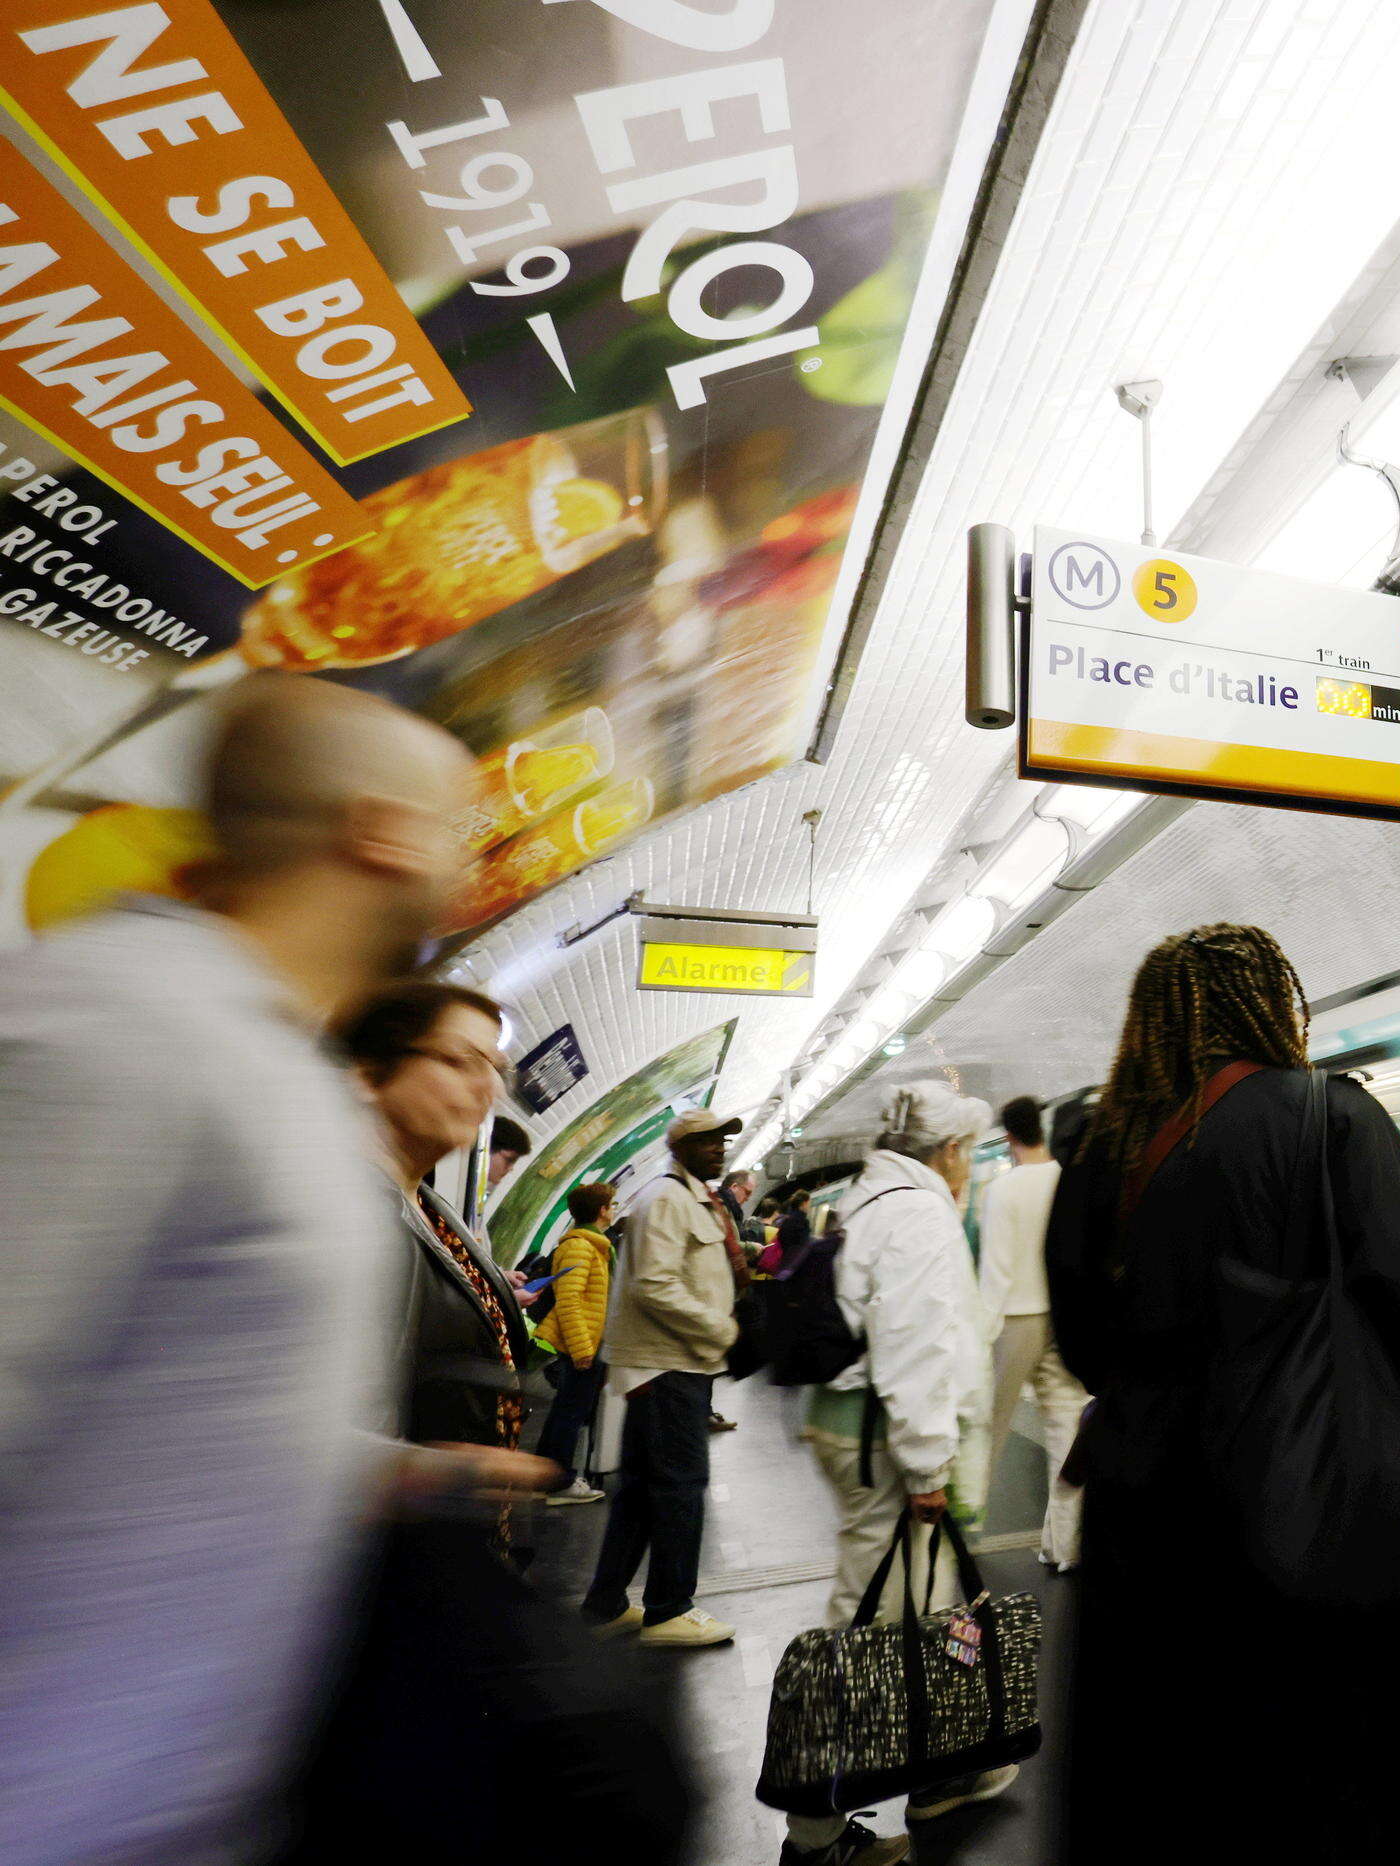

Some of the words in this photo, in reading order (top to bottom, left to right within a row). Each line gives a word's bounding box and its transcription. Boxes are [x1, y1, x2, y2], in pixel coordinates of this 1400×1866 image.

[17, 2, 245, 160] NE
[168, 176, 327, 278] SE
[254, 278, 434, 423] BOIT
[386, 96, 571, 297] 1919
[0, 203, 224, 452] AMAIS
[156, 437, 322, 550] SEUL
[0, 441, 118, 545] PEROL
[0, 525, 209, 657] RICCADONNA
[0, 588, 150, 671] GAZEUSE
[1153, 571, 1178, 609] 5
[1049, 644, 1154, 688] Place
[1169, 663, 1299, 709] d'Italie
[1338, 654, 1370, 669] train
[1373, 705, 1400, 721] min
[656, 956, 766, 982] Alarme
